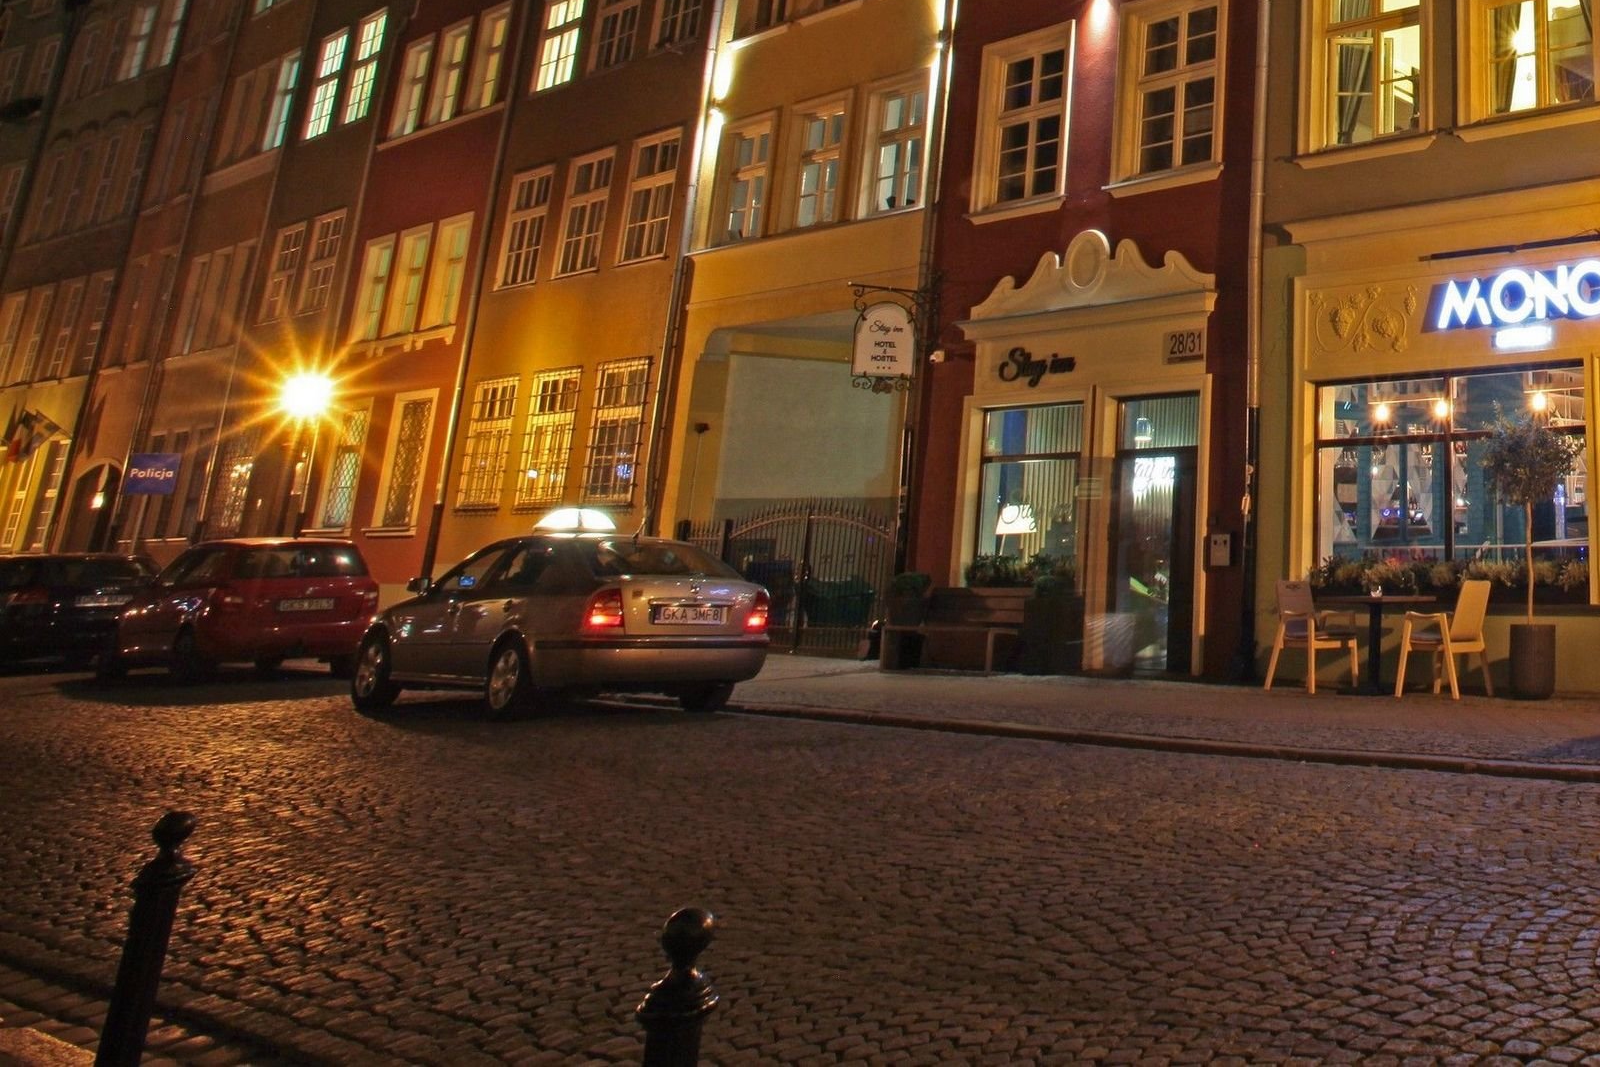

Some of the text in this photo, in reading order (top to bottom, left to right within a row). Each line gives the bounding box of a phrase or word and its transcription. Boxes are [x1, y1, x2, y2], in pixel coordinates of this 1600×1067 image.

[869, 320, 904, 335] Stay inn
[874, 341, 896, 349] HOTEL
[1170, 332, 1202, 355] 28/31
[871, 355, 898, 363] HOSTEL
[998, 347, 1076, 387] Stay inn
[130, 468, 174, 480] Policja
[663, 608, 719, 621] GKA 3MF8
